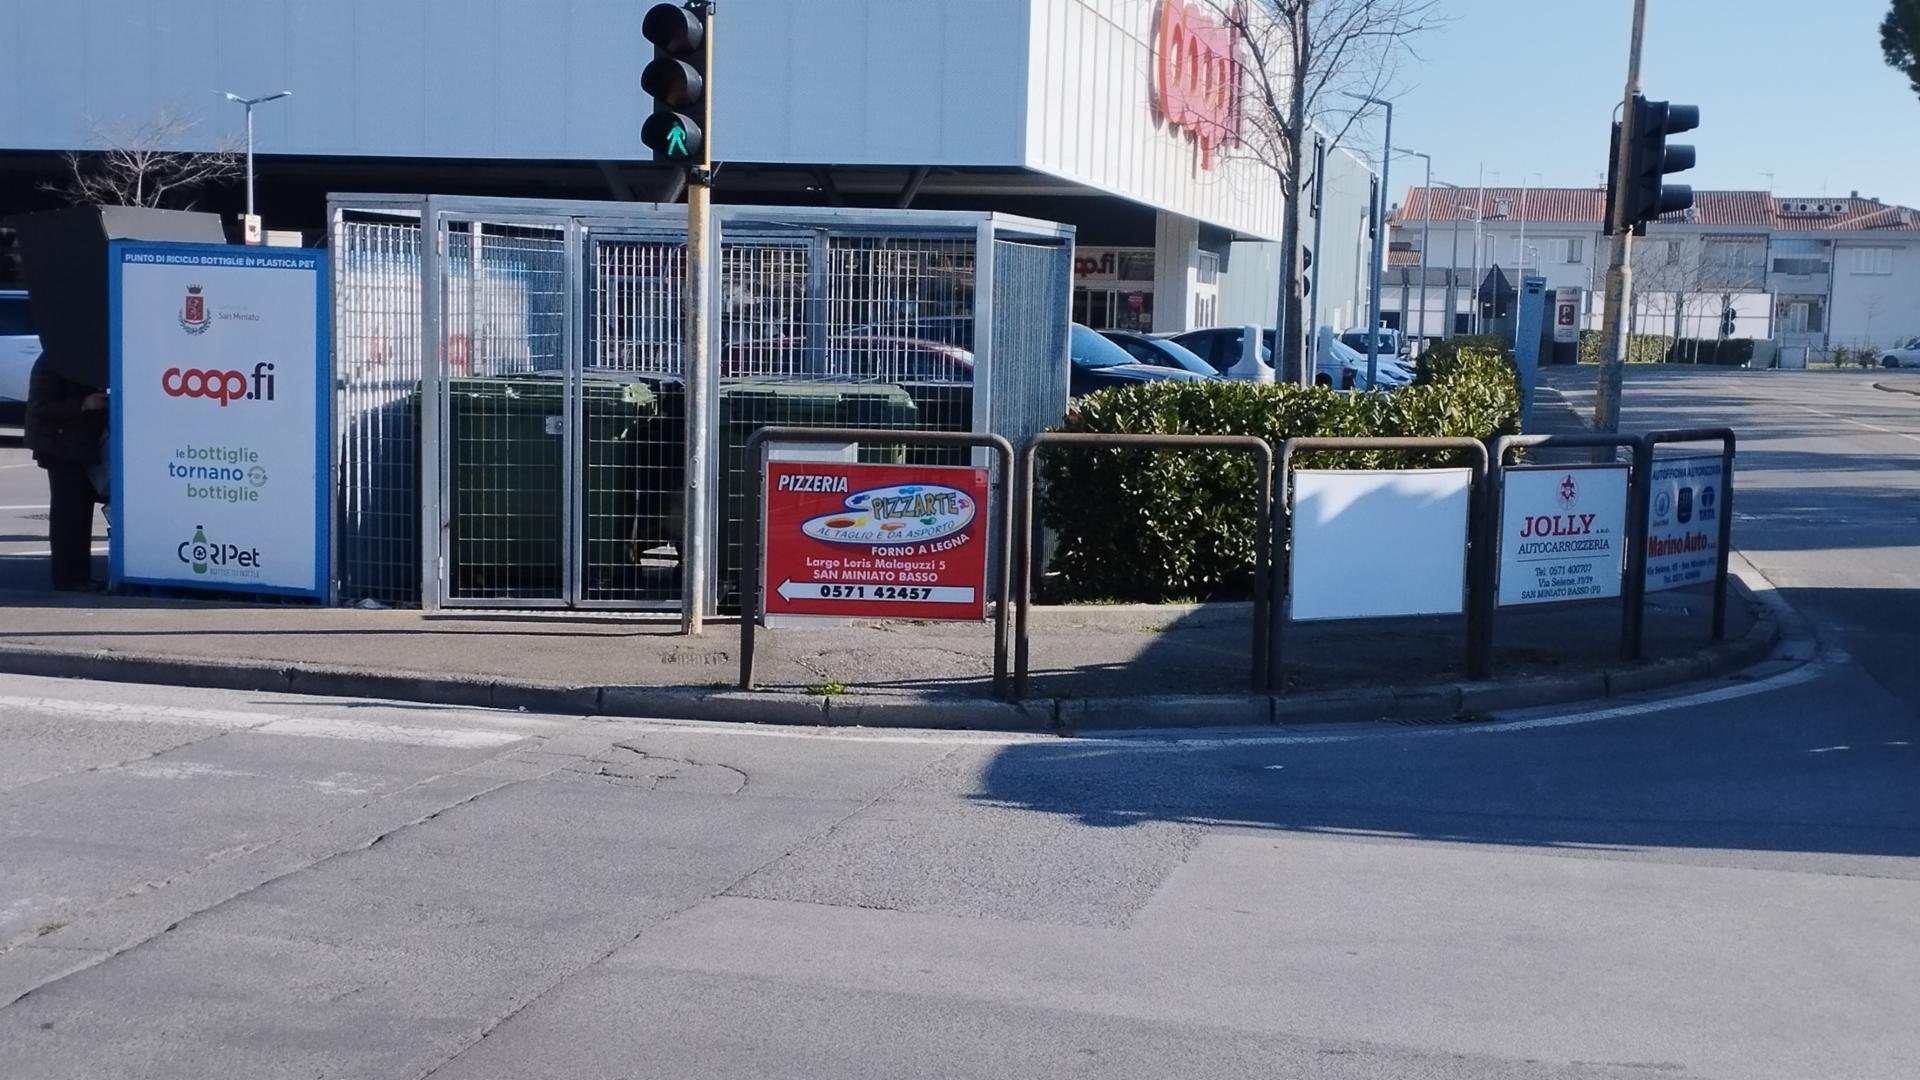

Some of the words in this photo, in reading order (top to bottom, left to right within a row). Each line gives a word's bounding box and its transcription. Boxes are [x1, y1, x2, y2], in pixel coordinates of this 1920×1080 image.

[125, 254, 154, 263] PUNTO
[156, 255, 165, 263] DI
[166, 255, 199, 264] RICICLO
[201, 256, 244, 266] BOTTIGLIE
[246, 257, 255, 266] IN
[257, 258, 297, 268] PLASTICA
[299, 260, 315, 269] PET
[162, 362, 275, 407] coop.fi
[176, 448, 186, 459] le
[187, 444, 259, 464] bottiglie
[168, 461, 244, 481] tornano
[187, 483, 259, 503] bottiglie
[777, 474, 849, 493] PIZZERIA
[871, 491, 960, 520] PIZZARTE
[1699, 509, 1715, 521] TATA
[816, 526, 832, 536] AL
[835, 529, 874, 539] TAGLIO
[876, 531, 884, 539] E
[887, 530, 903, 539] DA
[906, 520, 955, 538] ASPORTO
[1520, 514, 1595, 538] JOLLY
[871, 546, 914, 557] FORNO
[918, 545, 928, 554] A
[931, 533, 971, 553] LEGNA
[1518, 538, 1610, 555] AUTOCARROZZERIA
[1648, 533, 1683, 558] Marino
[1683, 530, 1707, 552] Auto
[806, 556, 840, 569] Largo
[843, 557, 872, 569] Loris
[874, 558, 935, 571] Malaguzzi
[938, 560, 946, 570] 5
[1549, 566, 1565, 576] 0571
[813, 569, 840, 580] SAN
[842, 570, 896, 582] MINIATO
[899, 571, 938, 583] BASSO
[1538, 578, 1550, 587] Via
[820, 584, 864, 599] 0571
[873, 586, 932, 600] 42457
[1521, 590, 1536, 600] SAN
[1537, 587, 1567, 599] MINIATO
[1567, 585, 1590, 596] BASSO
